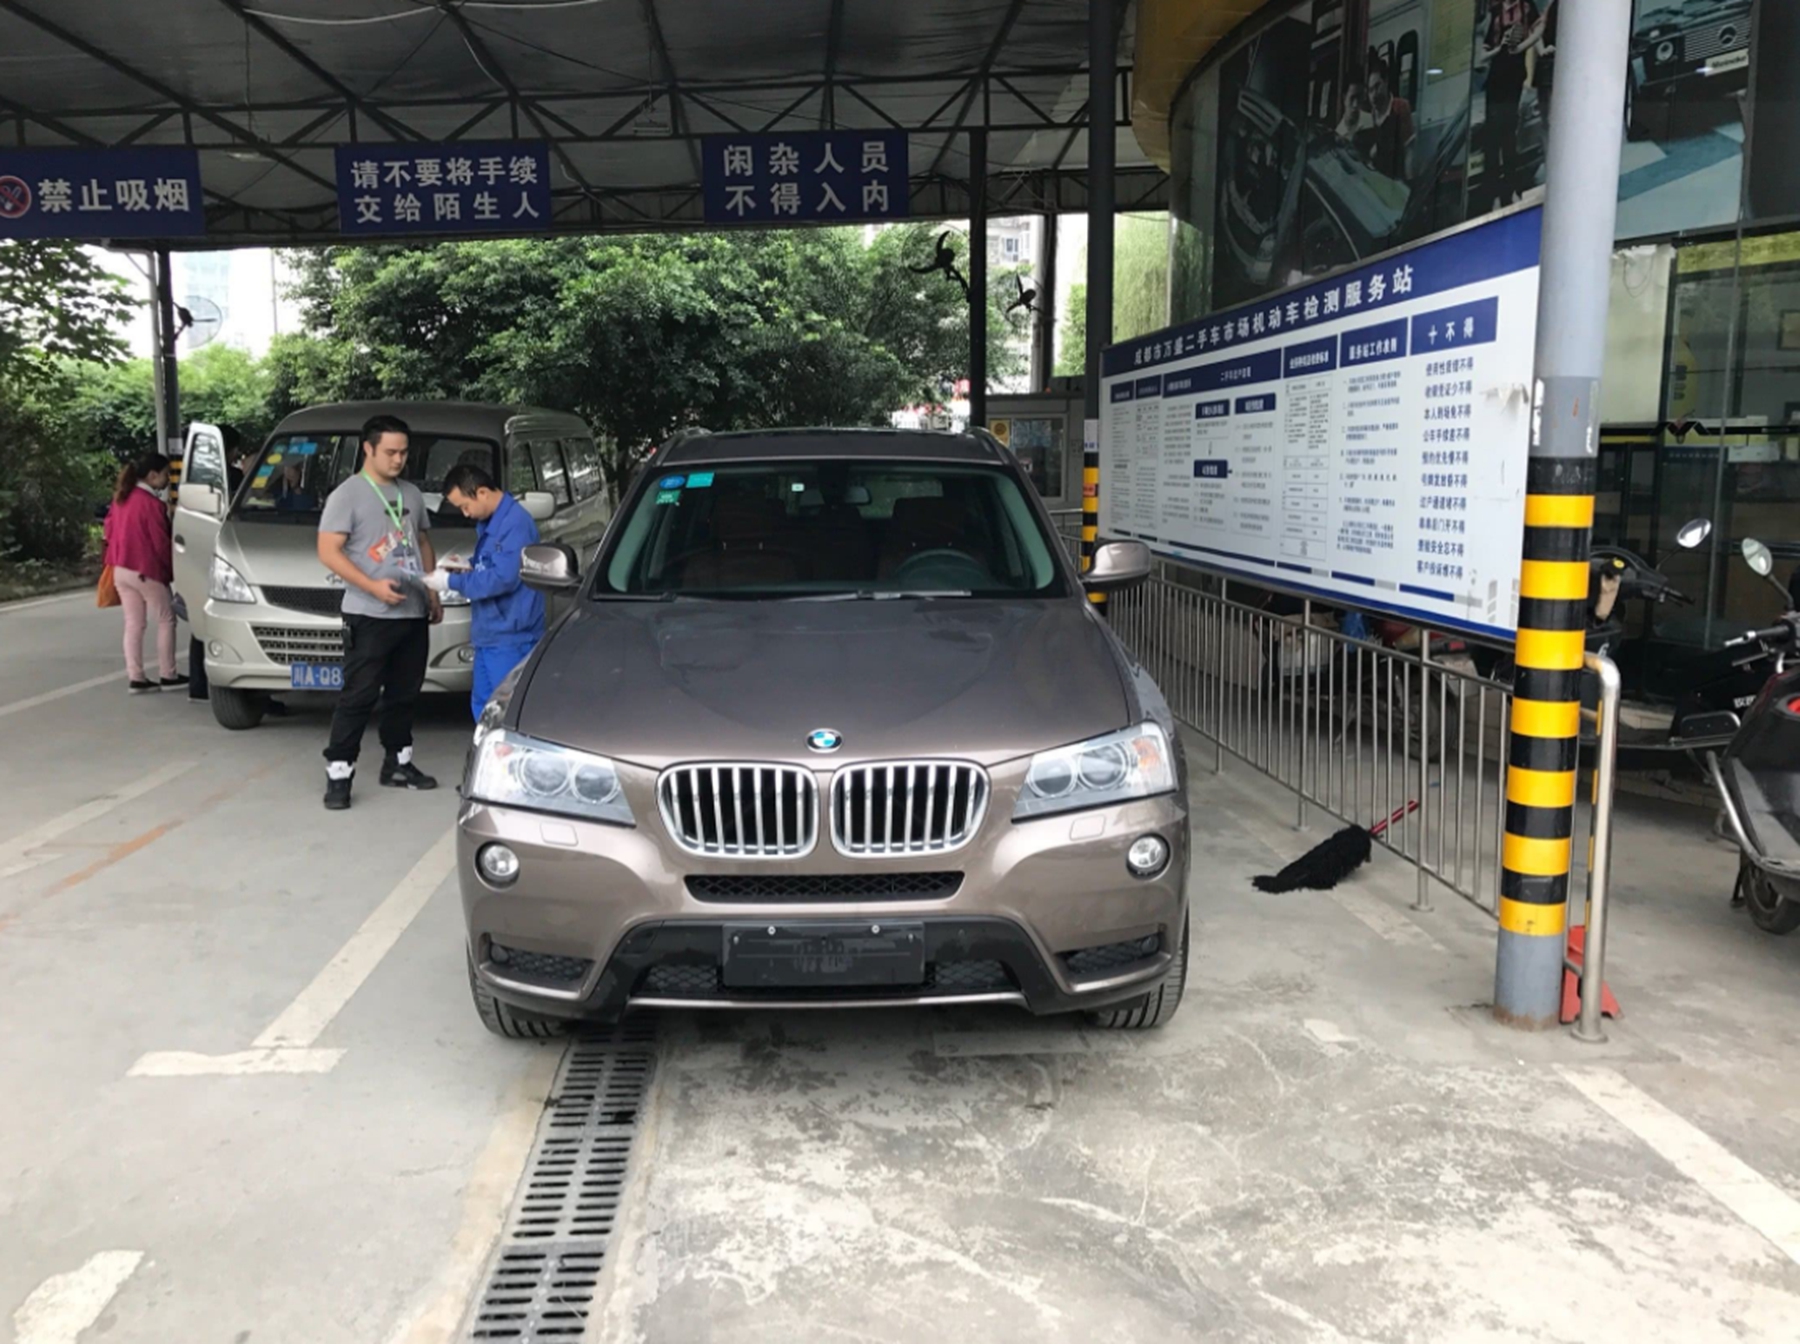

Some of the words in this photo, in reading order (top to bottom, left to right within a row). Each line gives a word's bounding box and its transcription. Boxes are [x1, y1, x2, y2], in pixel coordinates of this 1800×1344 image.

[351, 156, 538, 189] 请不要将手续
[723, 141, 889, 177] 闲杂人员
[38, 177, 190, 213] 禁止吸烟
[354, 191, 539, 224] 交给陌生人
[725, 179, 889, 217] 不得入内
[1428, 316, 1474, 345] 十不得
